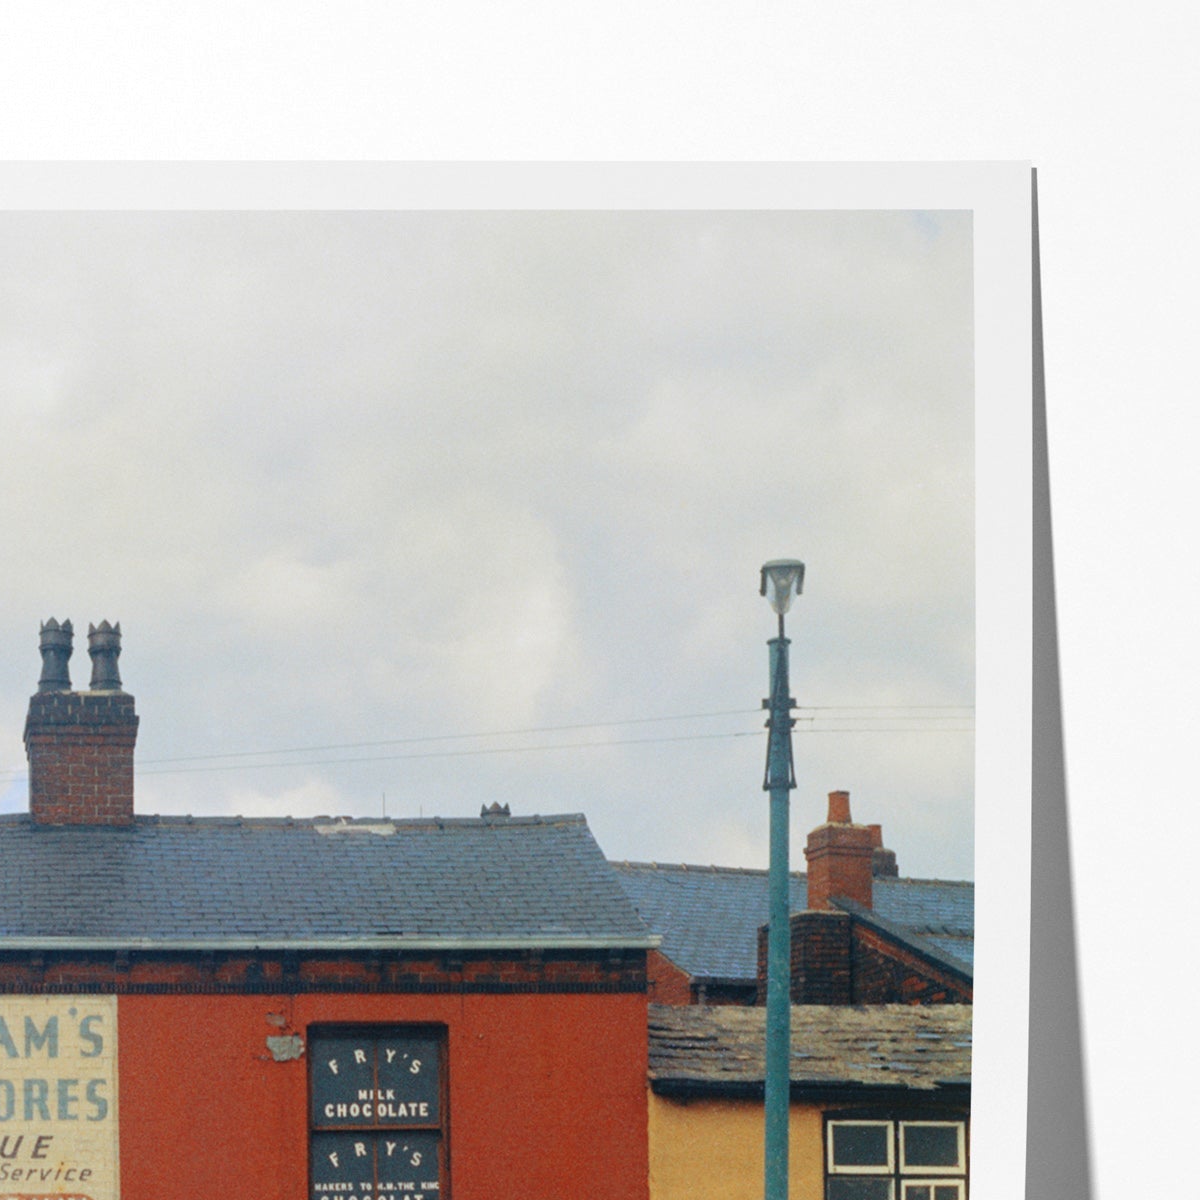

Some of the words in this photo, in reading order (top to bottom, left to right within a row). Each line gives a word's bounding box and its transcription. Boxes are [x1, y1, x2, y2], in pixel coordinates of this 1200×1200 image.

[328, 1049, 422, 1075] FRY'S
[358, 1089, 395, 1101] MILK
[324, 1103, 429, 1117] CHOCOLATE
[328, 1141, 422, 1168] FRY'S
[314, 1183, 353, 1191] MAKERS
[360, 1183, 372, 1191] TO
